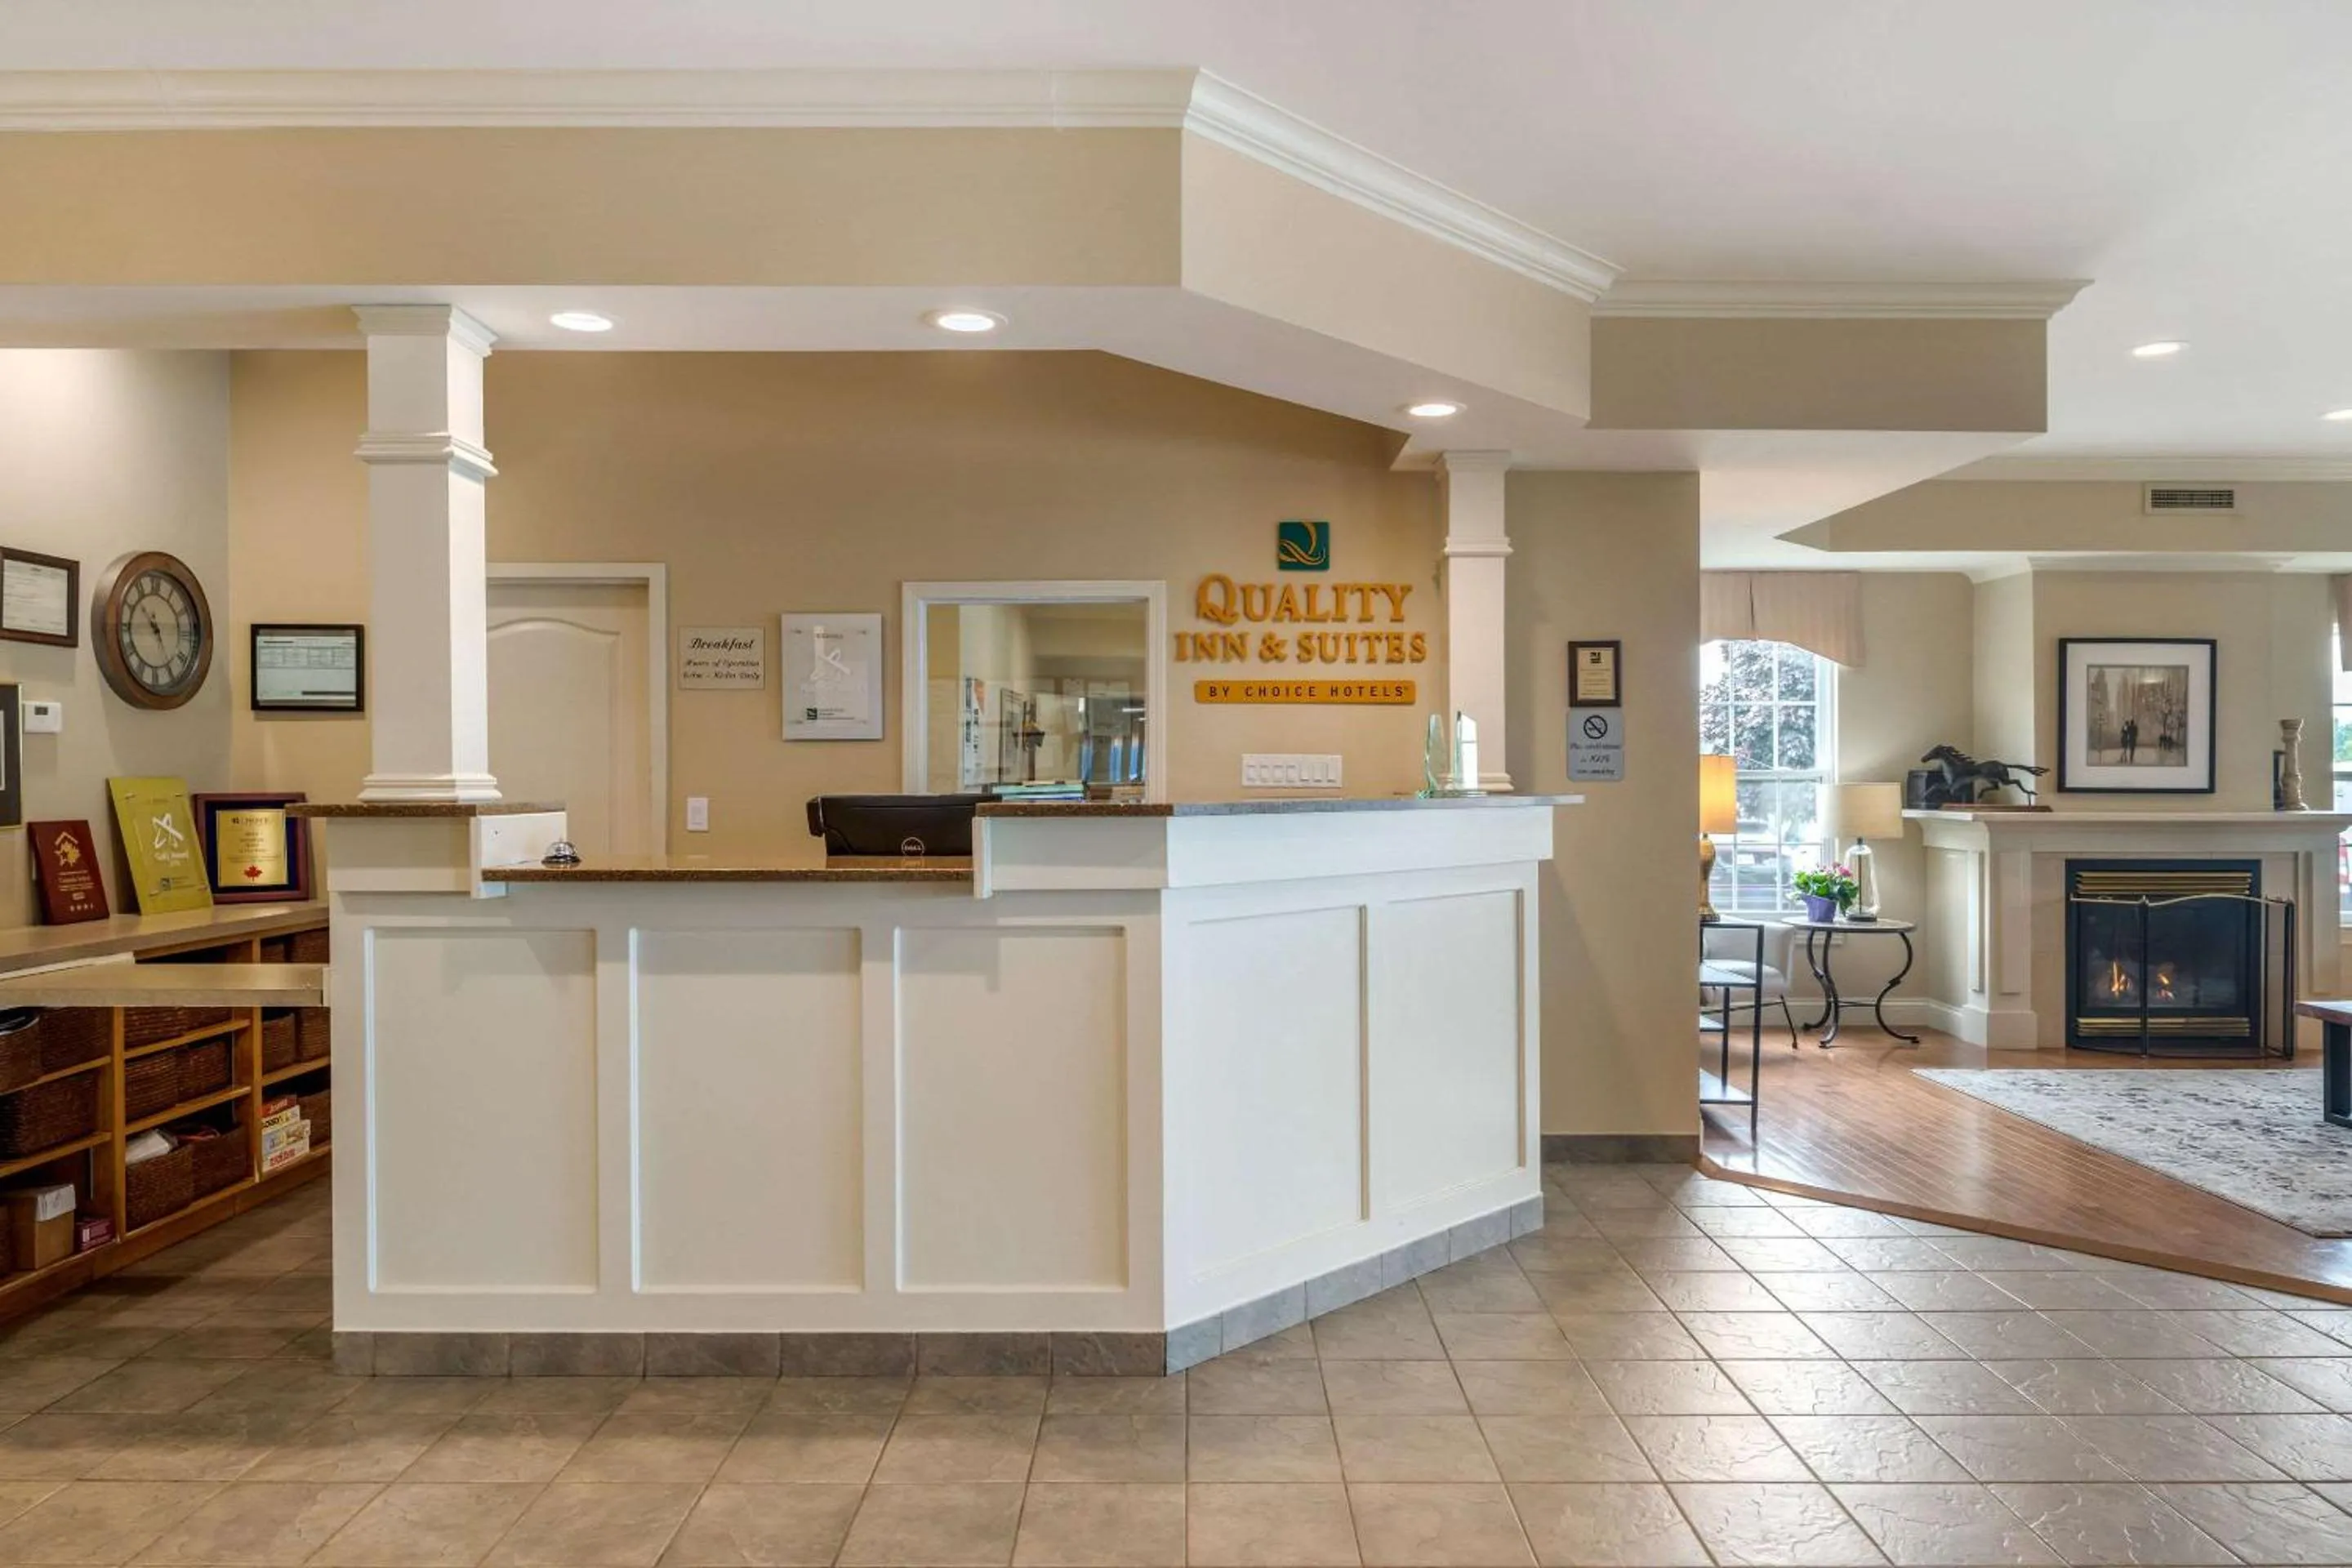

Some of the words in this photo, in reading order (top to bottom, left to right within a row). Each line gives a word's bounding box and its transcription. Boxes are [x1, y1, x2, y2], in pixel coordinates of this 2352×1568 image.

[1196, 573, 1413, 626] QUALITY
[689, 638, 755, 652] Breakfast
[1174, 632, 1250, 663] INN
[1258, 631, 1289, 664] &
[1297, 632, 1428, 664] SUITES
[1209, 686, 1230, 697] BY
[1245, 686, 1316, 697] CHOICE
[1330, 686, 1404, 697] HOTELS
